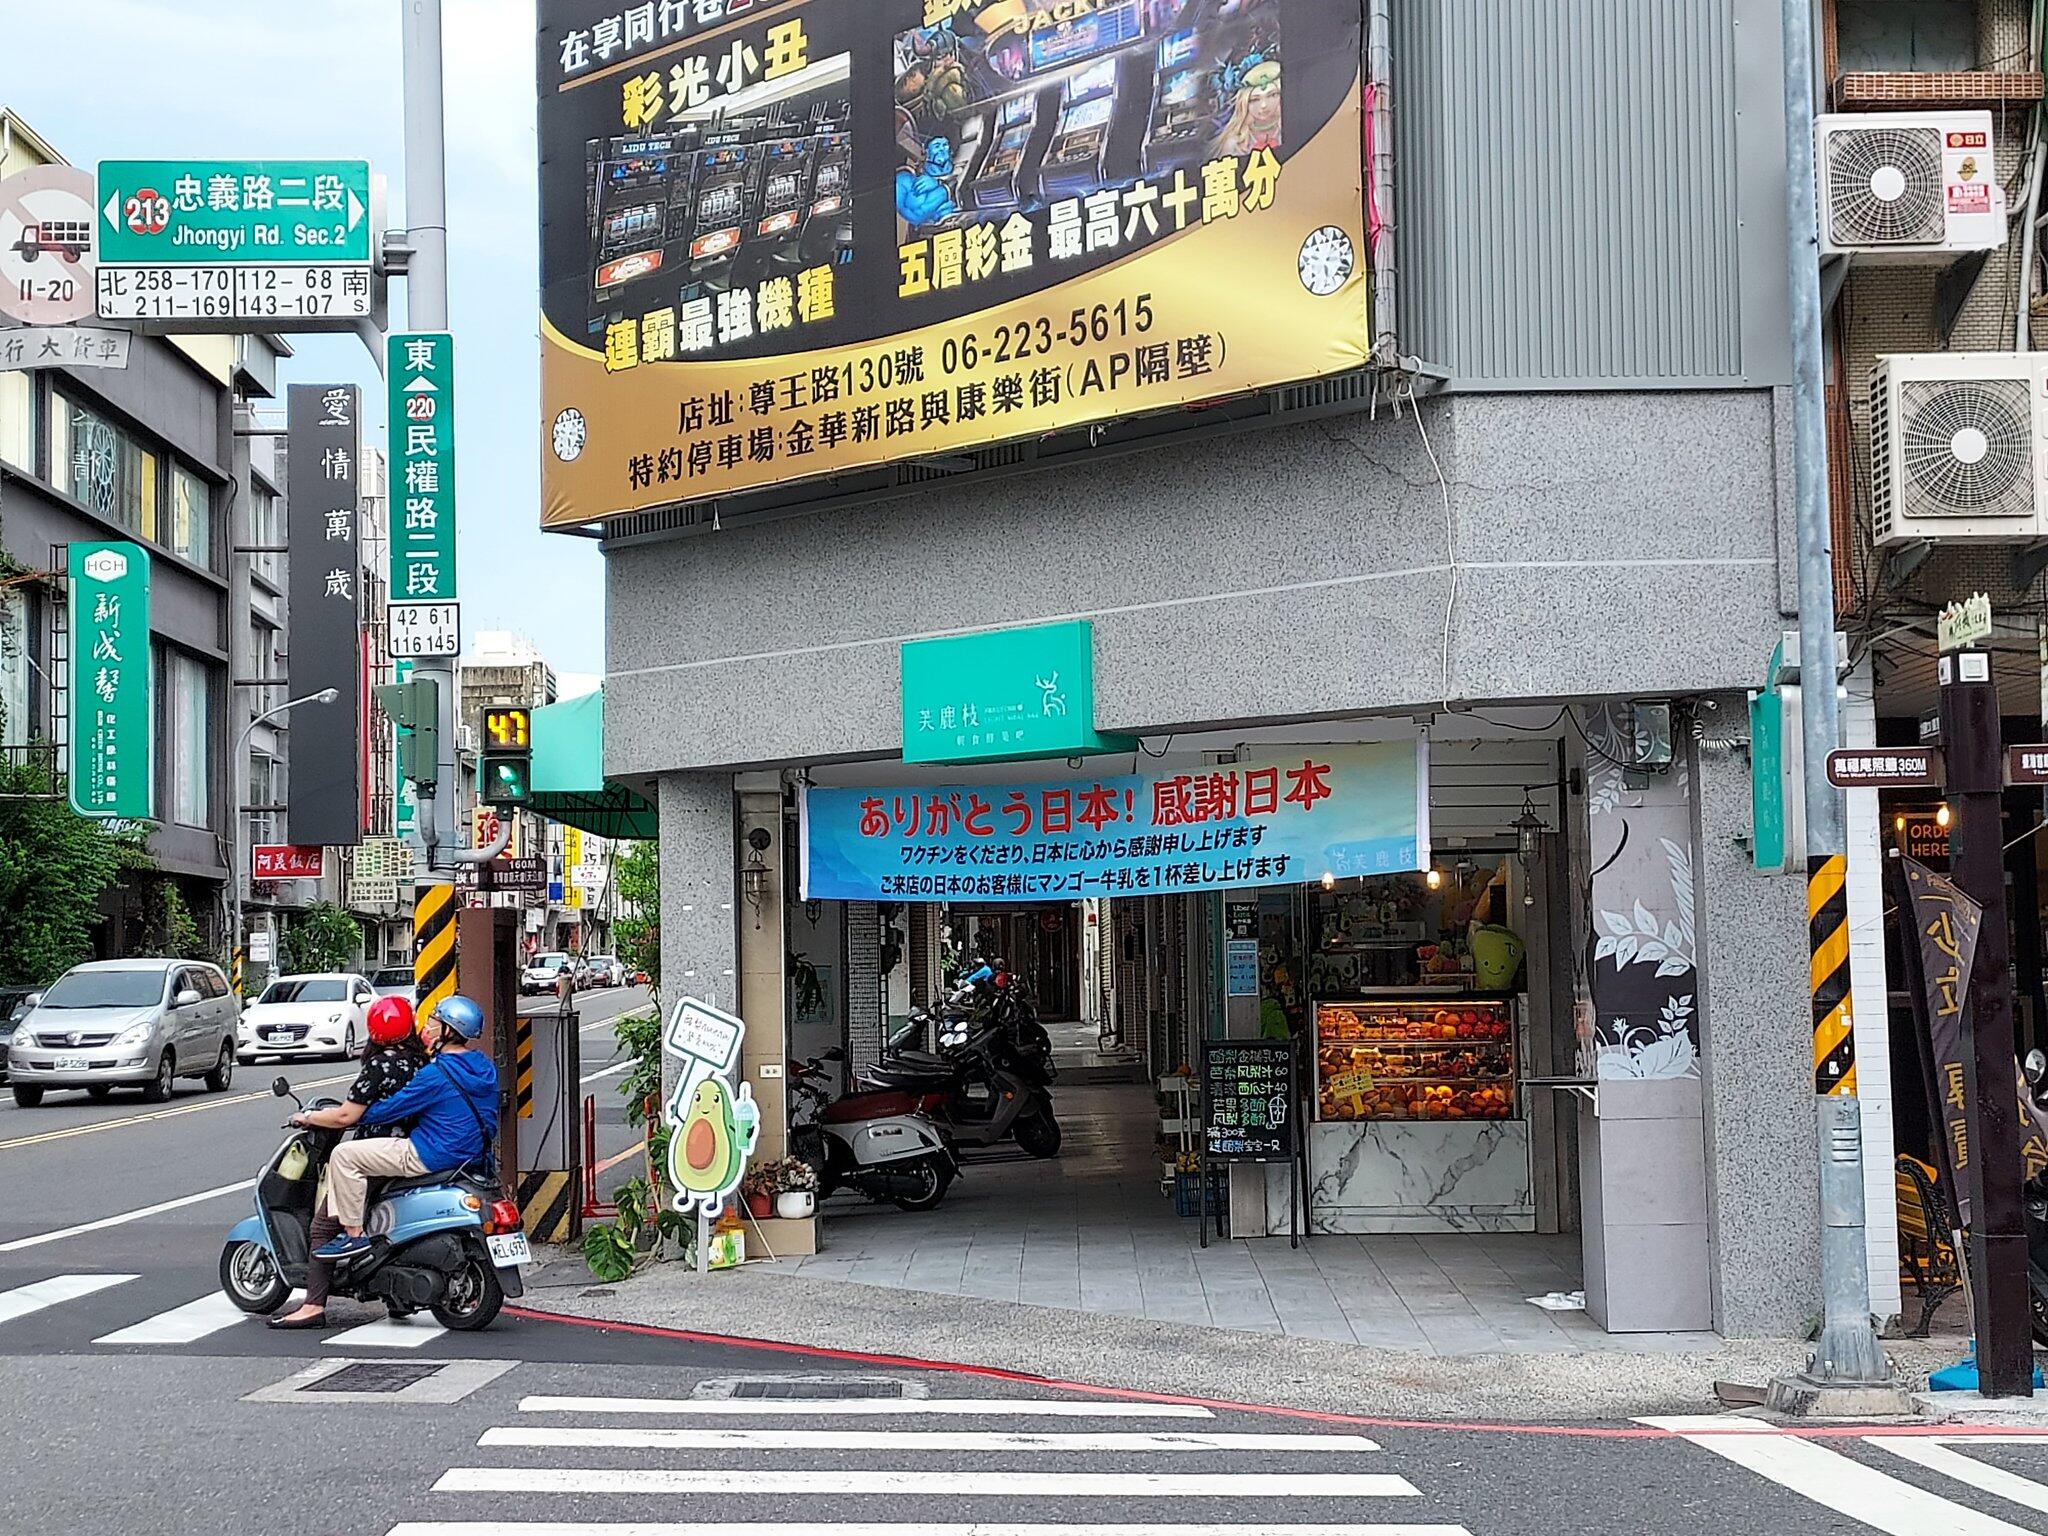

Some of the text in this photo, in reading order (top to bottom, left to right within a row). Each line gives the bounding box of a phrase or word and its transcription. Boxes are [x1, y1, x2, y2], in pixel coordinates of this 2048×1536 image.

[621, 17, 810, 128] 彩光小丑
[126, 173, 346, 226] 213 忠義路二段
[172, 224, 347, 252] Jhongyi Rd. Sec.2
[898, 146, 1283, 298] 五層彩金 最高六十萬分
[100, 271, 128, 297] 北
[134, 270, 230, 291] 258-170
[342, 270, 369, 297] 南
[134, 295, 231, 316] 211-169
[239, 294, 334, 316] 143-107
[604, 263, 836, 374] 連霸最強機種
[403, 338, 437, 372] 東
[677, 293, 1153, 435] 店址:尊王路130號 06-223-5615
[406, 397, 436, 419] 220
[319, 387, 353, 601] 愛情萬歲
[404, 424, 440, 596] 民權路二段
[87, 559, 124, 572] HCH
[397, 607, 450, 626] 42 61
[392, 634, 456, 654] 116 145
[487, 710, 527, 746] 47
[1151, 758, 1332, 827] 感謝日本
[899, 824, 1268, 866] ワクチンをくださり、日本に心から感謝申し上げます
[1911, 842, 1950, 857] HERE
[880, 853, 1292, 896] ご来店の日本のお客様にマンゴー牛乳を1杯差し上げます
[1274, 1065, 1289, 1077] 60
[1274, 1082, 1288, 1093] 40
